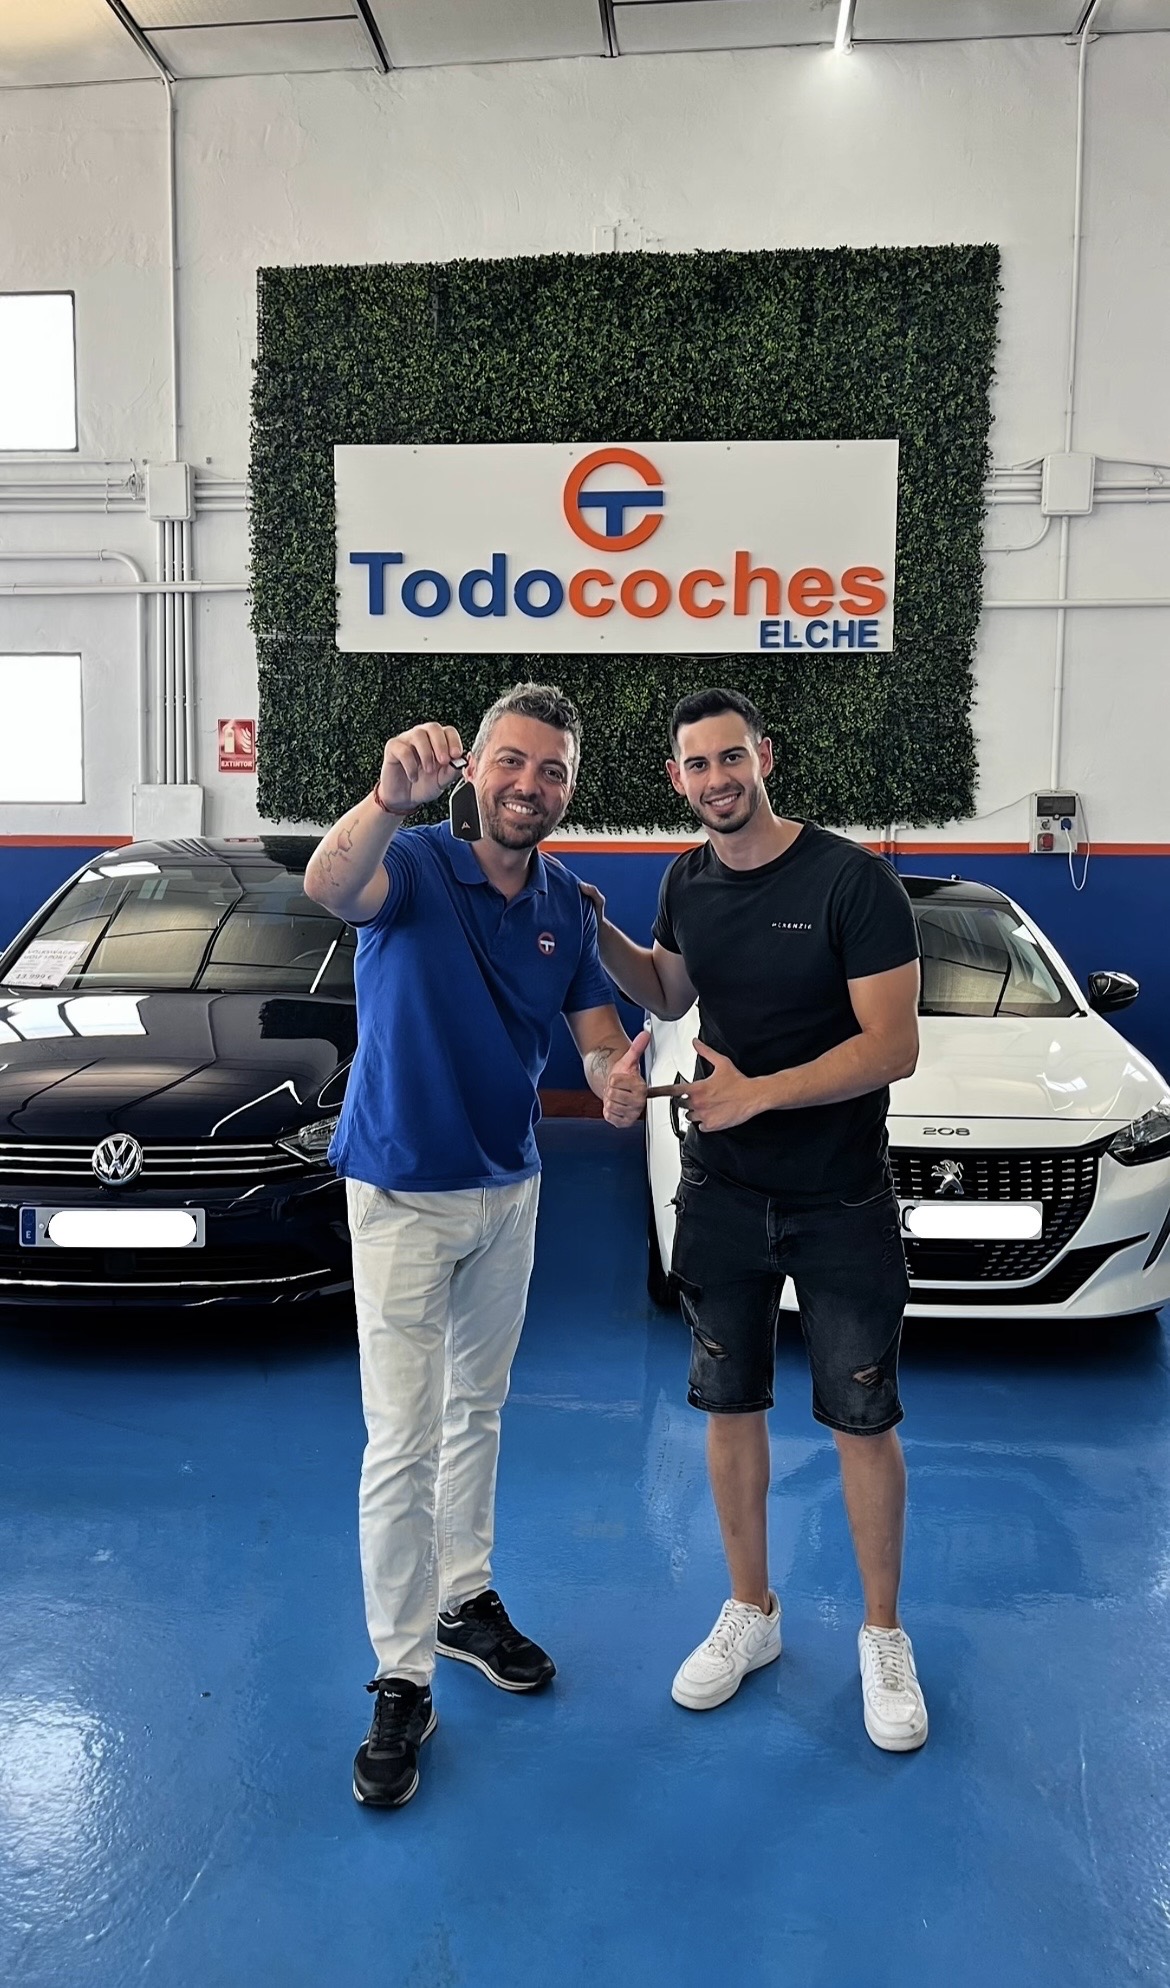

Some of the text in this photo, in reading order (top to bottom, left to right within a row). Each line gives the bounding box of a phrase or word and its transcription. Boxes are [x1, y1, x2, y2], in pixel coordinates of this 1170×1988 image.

[349, 551, 887, 619] Todocoches
[760, 620, 879, 649] ELCHE
[221, 760, 253, 768] EXTINTOR
[922, 1127, 971, 1136] 208
[25, 1230, 32, 1239] E
